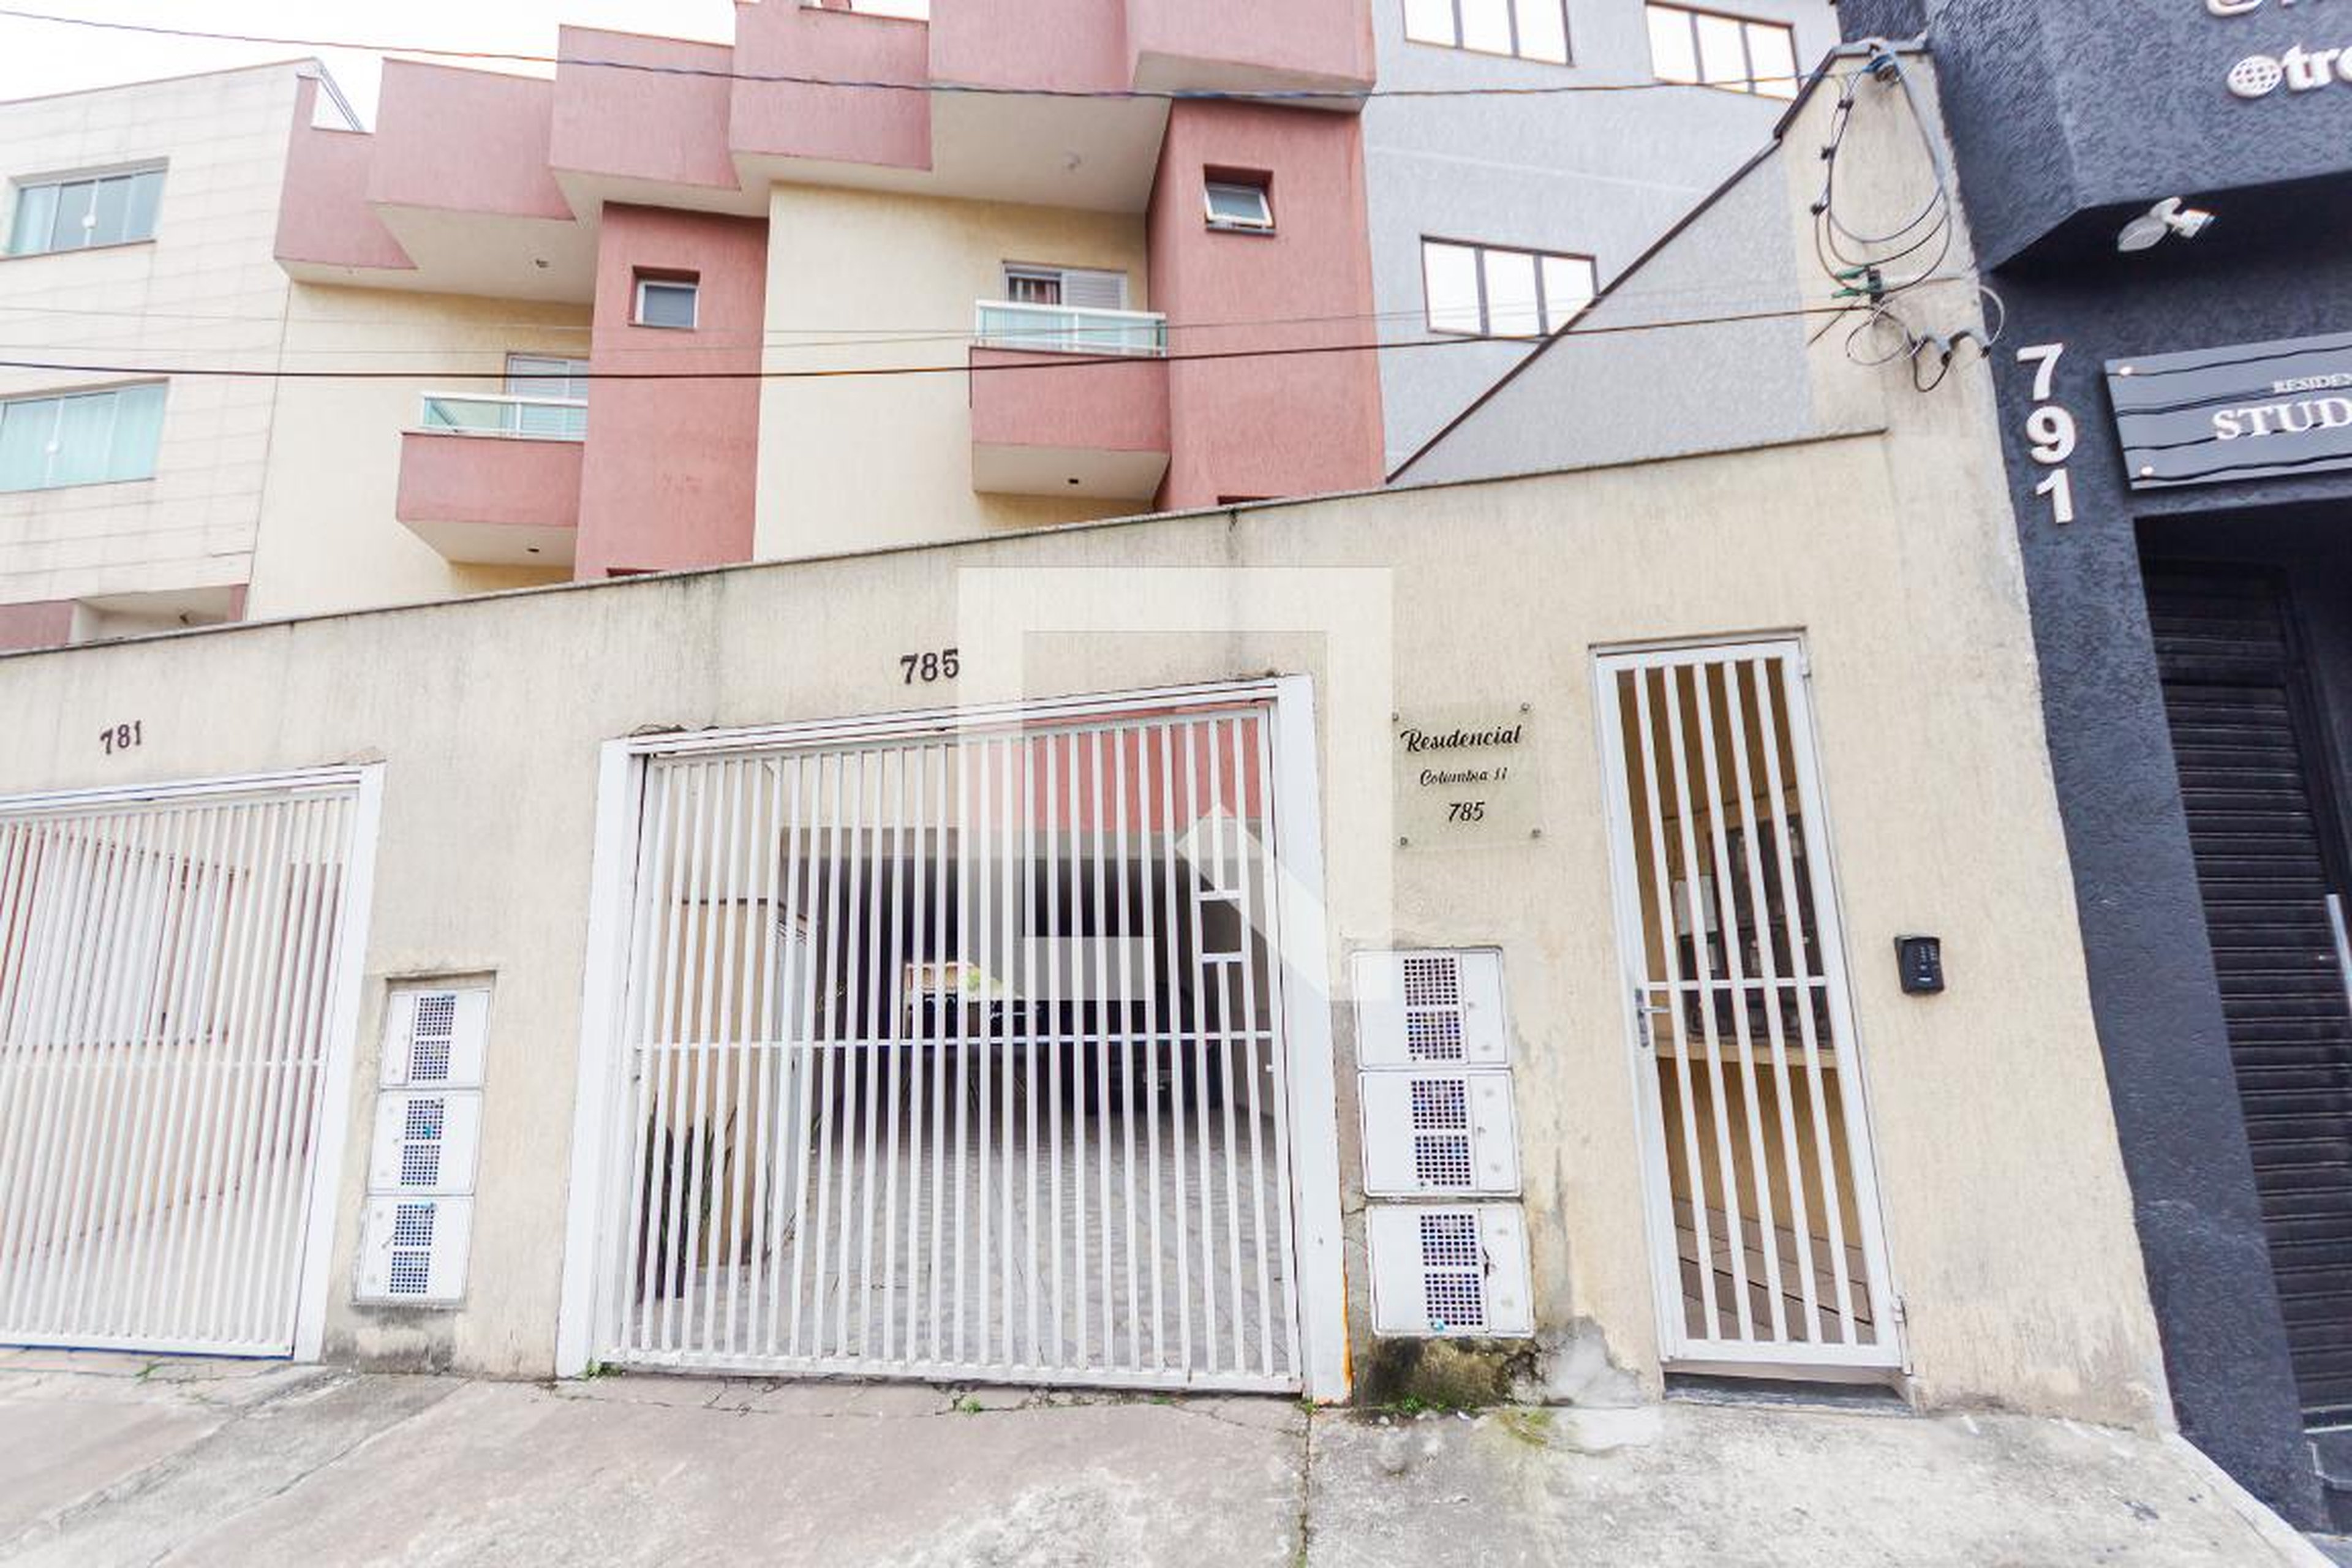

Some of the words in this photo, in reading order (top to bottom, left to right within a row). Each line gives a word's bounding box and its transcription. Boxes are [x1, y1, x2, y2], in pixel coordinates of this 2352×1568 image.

[2016, 343, 2076, 524] 791
[2213, 398, 2352, 440] STUD
[900, 648, 960, 684] 785
[100, 720, 141, 755] 781
[1400, 725, 1521, 752] Residencial
[1449, 801, 1485, 823] 785
